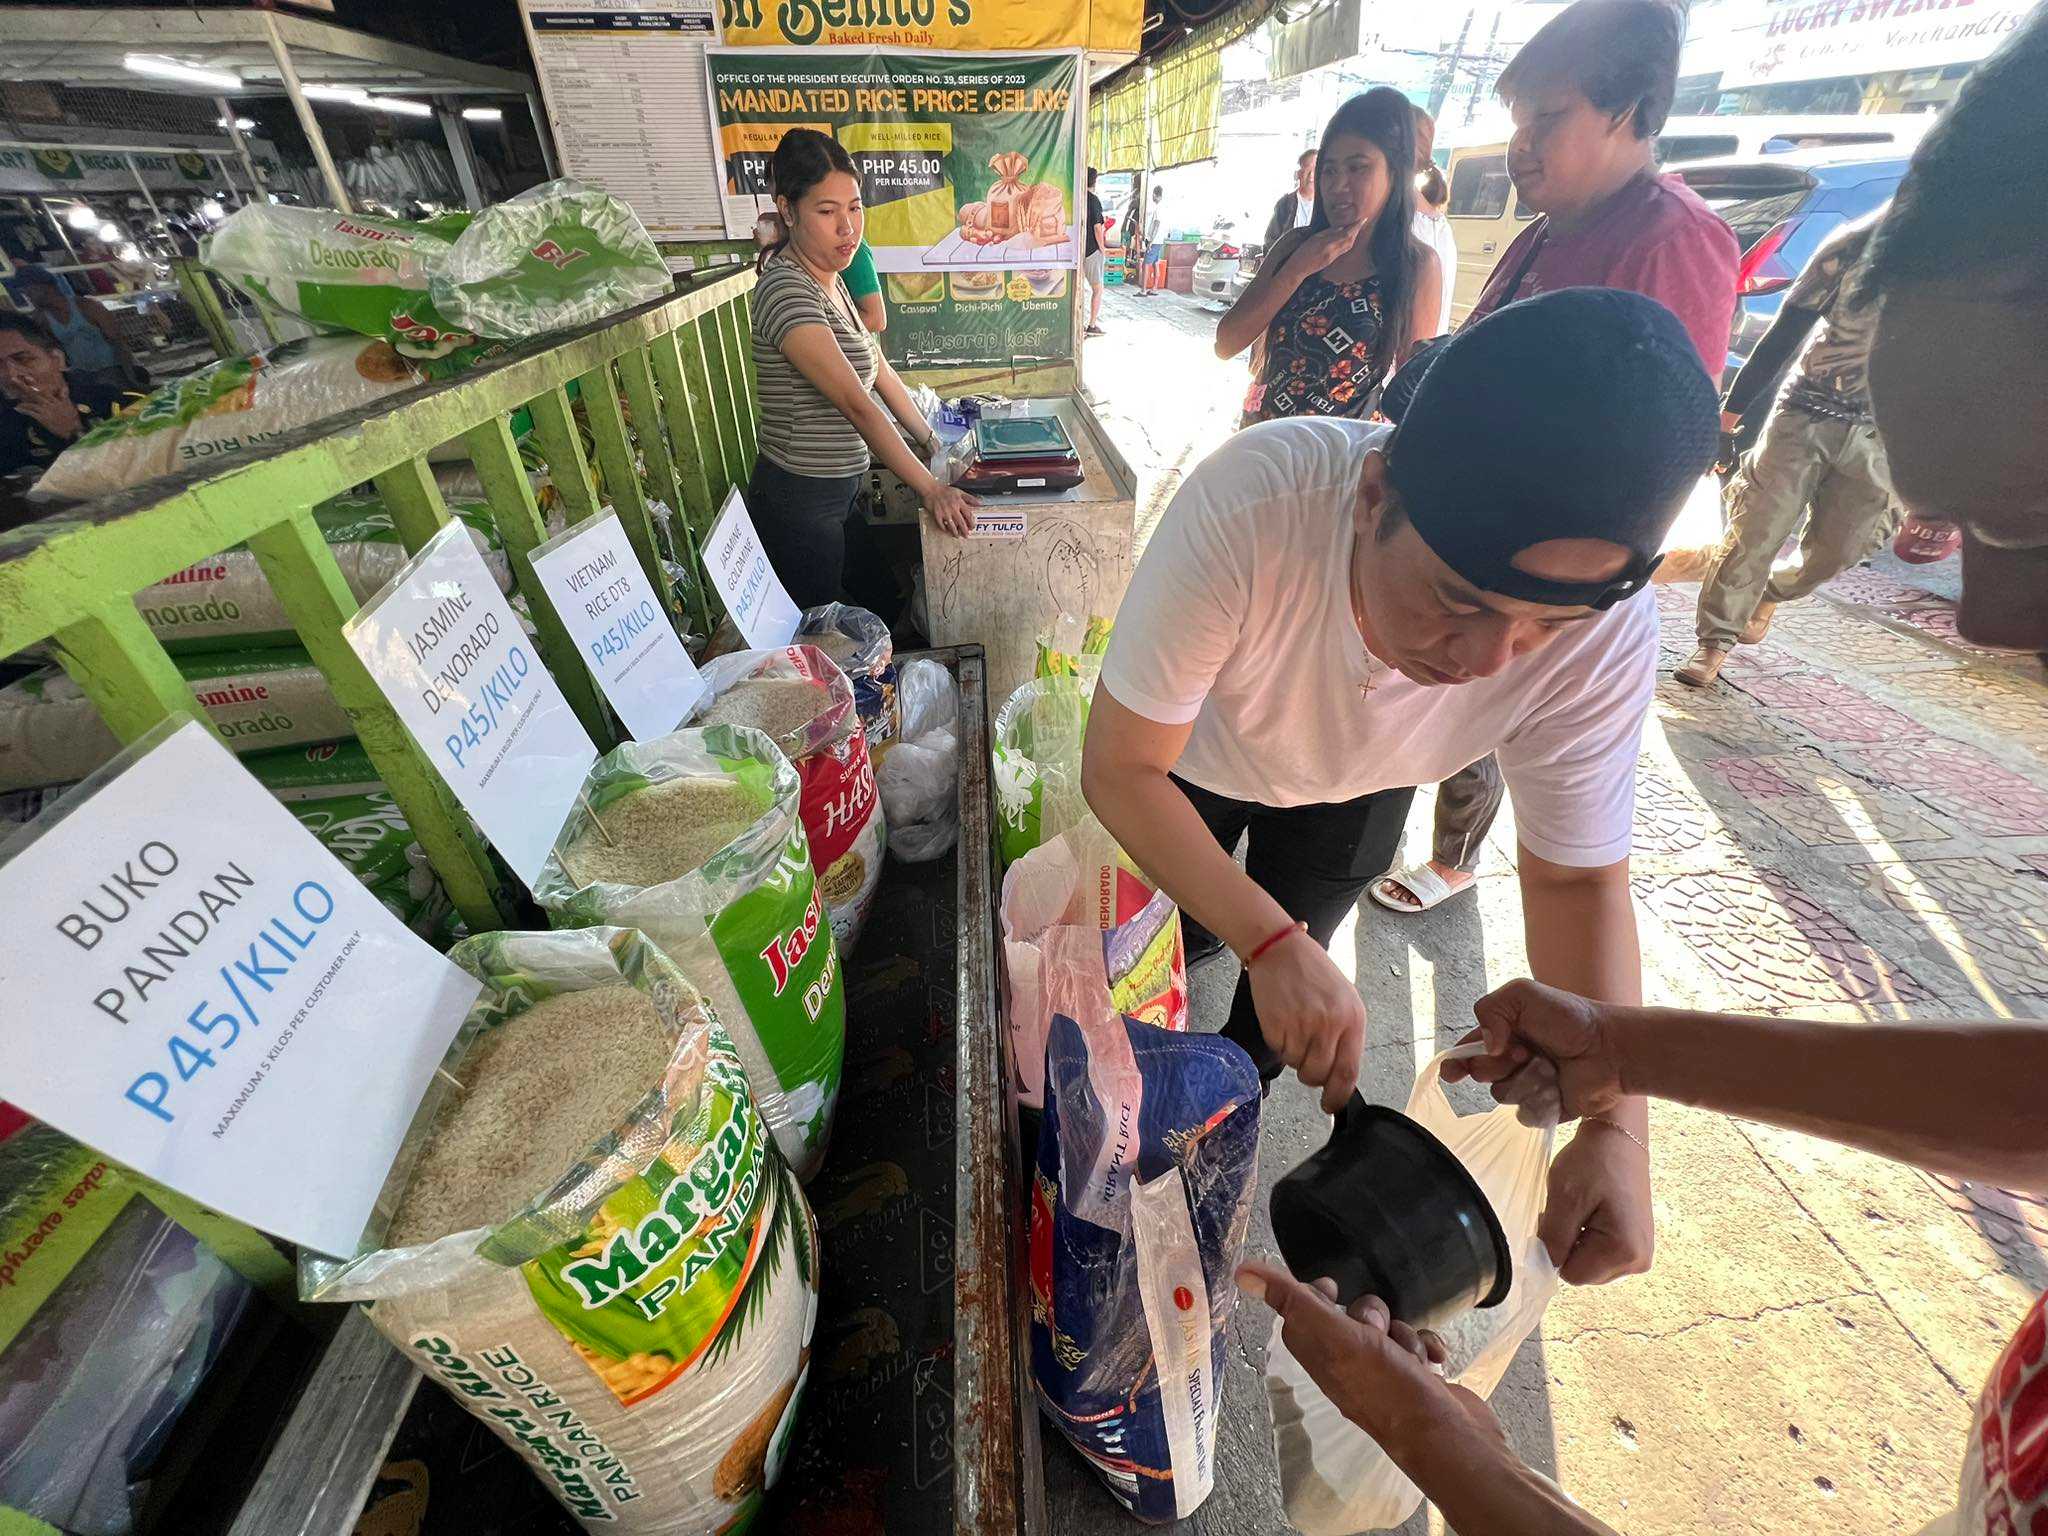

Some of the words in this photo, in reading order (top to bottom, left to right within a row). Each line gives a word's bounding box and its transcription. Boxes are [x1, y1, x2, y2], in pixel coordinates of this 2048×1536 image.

[778, 0, 971, 46] Benitos
[829, 32, 865, 44] Baked
[868, 32, 901, 44] Fresh
[904, 31, 935, 45] Daily
[717, 74, 750, 84] OFFICE
[752, 74, 766, 84] OF
[767, 75, 786, 84] THE
[788, 74, 839, 84] PRESIDENT
[841, 75, 890, 84] EXECUTIVE
[892, 75, 924, 84] ORDER
[926, 75, 943, 84] NO.
[944, 76, 957, 85] 39,
[958, 76, 989, 84] SERIES
[991, 75, 1003, 84] OF
[1005, 75, 1026, 84] 2023
[719, 89, 849, 112] MANDATED
[855, 89, 907, 112] RICE
[913, 89, 978, 112] PRICE
[984, 89, 1070, 112] CEILING
[743, 133, 779, 142] REGULAR
[871, 133, 922, 142] WELL-MILLED
[925, 133, 941, 141] RICE
[743, 159, 765, 175] PH
[863, 159, 895, 174] PHP
[898, 159, 940, 174] 45.00
[875, 178, 890, 186] PER
[891, 178, 930, 186] KILOGRAM
[900, 304, 938, 314] Cassava
[955, 303, 1003, 312] Pichi-Pichi
[1022, 301, 1058, 311] Ubenito
[721, 524, 742, 569] JASMINE
[992, 523, 1024, 531] TULFO
[566, 550, 618, 593] VIETNAM
[736, 556, 765, 622] P45/KILO
[145, 594, 240, 626] norado
[585, 591, 611, 620] RICE
[608, 576, 631, 602] DT8
[408, 584, 473, 665] JASMINE
[591, 600, 654, 666] P45/KILO
[422, 612, 499, 714] DENORADO
[196, 683, 270, 708] smine
[446, 646, 528, 769] P45/KILO
[218, 711, 293, 738] orado
[56, 841, 178, 951] BUKO
[93, 862, 255, 1025] PANDAN
[124, 881, 334, 1123] P45/KILO
[212, 1066, 266, 1140] MAXIMUM
[267, 1029, 294, 1063] KILOS
[290, 1008, 310, 1032] PER
[305, 953, 346, 1010] CUSTOMER
[342, 930, 362, 958] ONLY
[0, 1212, 63, 1288] everyd
[481, 1344, 559, 1410] RICE
[548, 1408, 641, 1506] PANDAN
